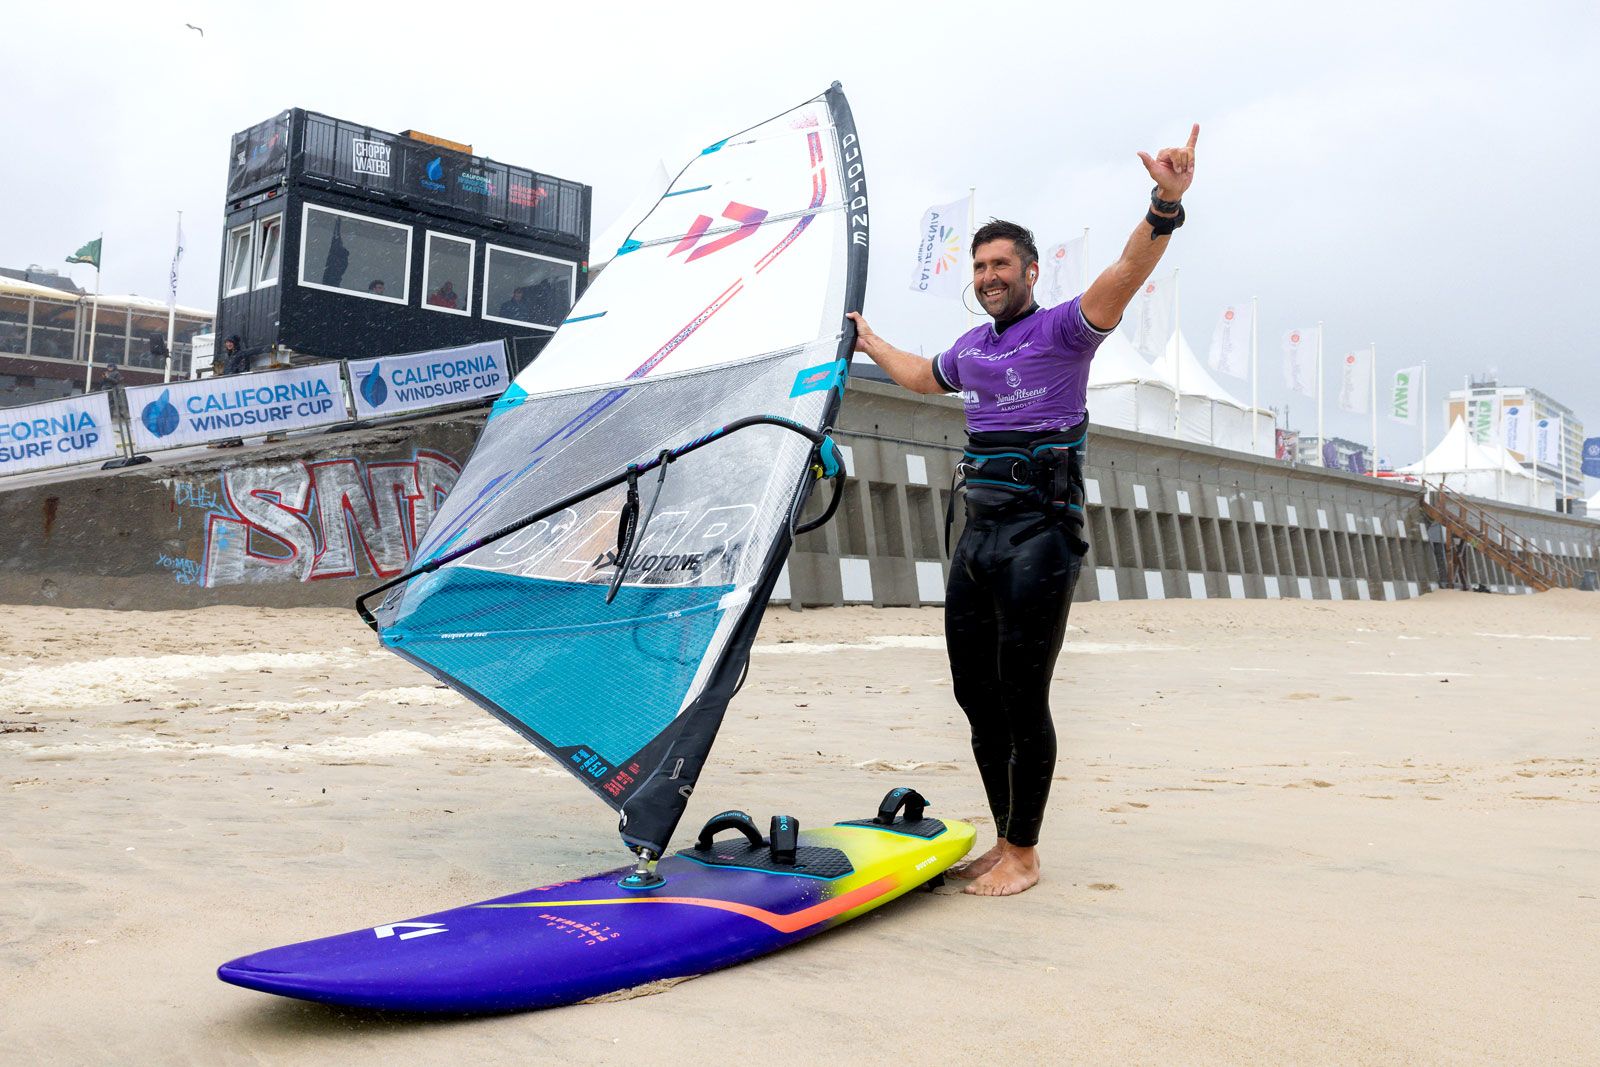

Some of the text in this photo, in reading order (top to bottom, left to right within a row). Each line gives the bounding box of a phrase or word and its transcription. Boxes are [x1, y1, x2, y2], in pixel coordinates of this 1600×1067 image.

[355, 142, 391, 160] CHOPPY
[842, 133, 868, 247] DUOTONE
[392, 355, 498, 386] CALIFORNIA
[186, 378, 331, 415] CALIFORNIA
[394, 373, 500, 403] WINDSURF CUP
[1014, 387, 1047, 400] Pilsener
[190, 399, 333, 433] WINDSURF CUP
[57, 432, 99, 453] CUP
[628, 553, 705, 572] UOTONE
[590, 921, 620, 938] SLS
